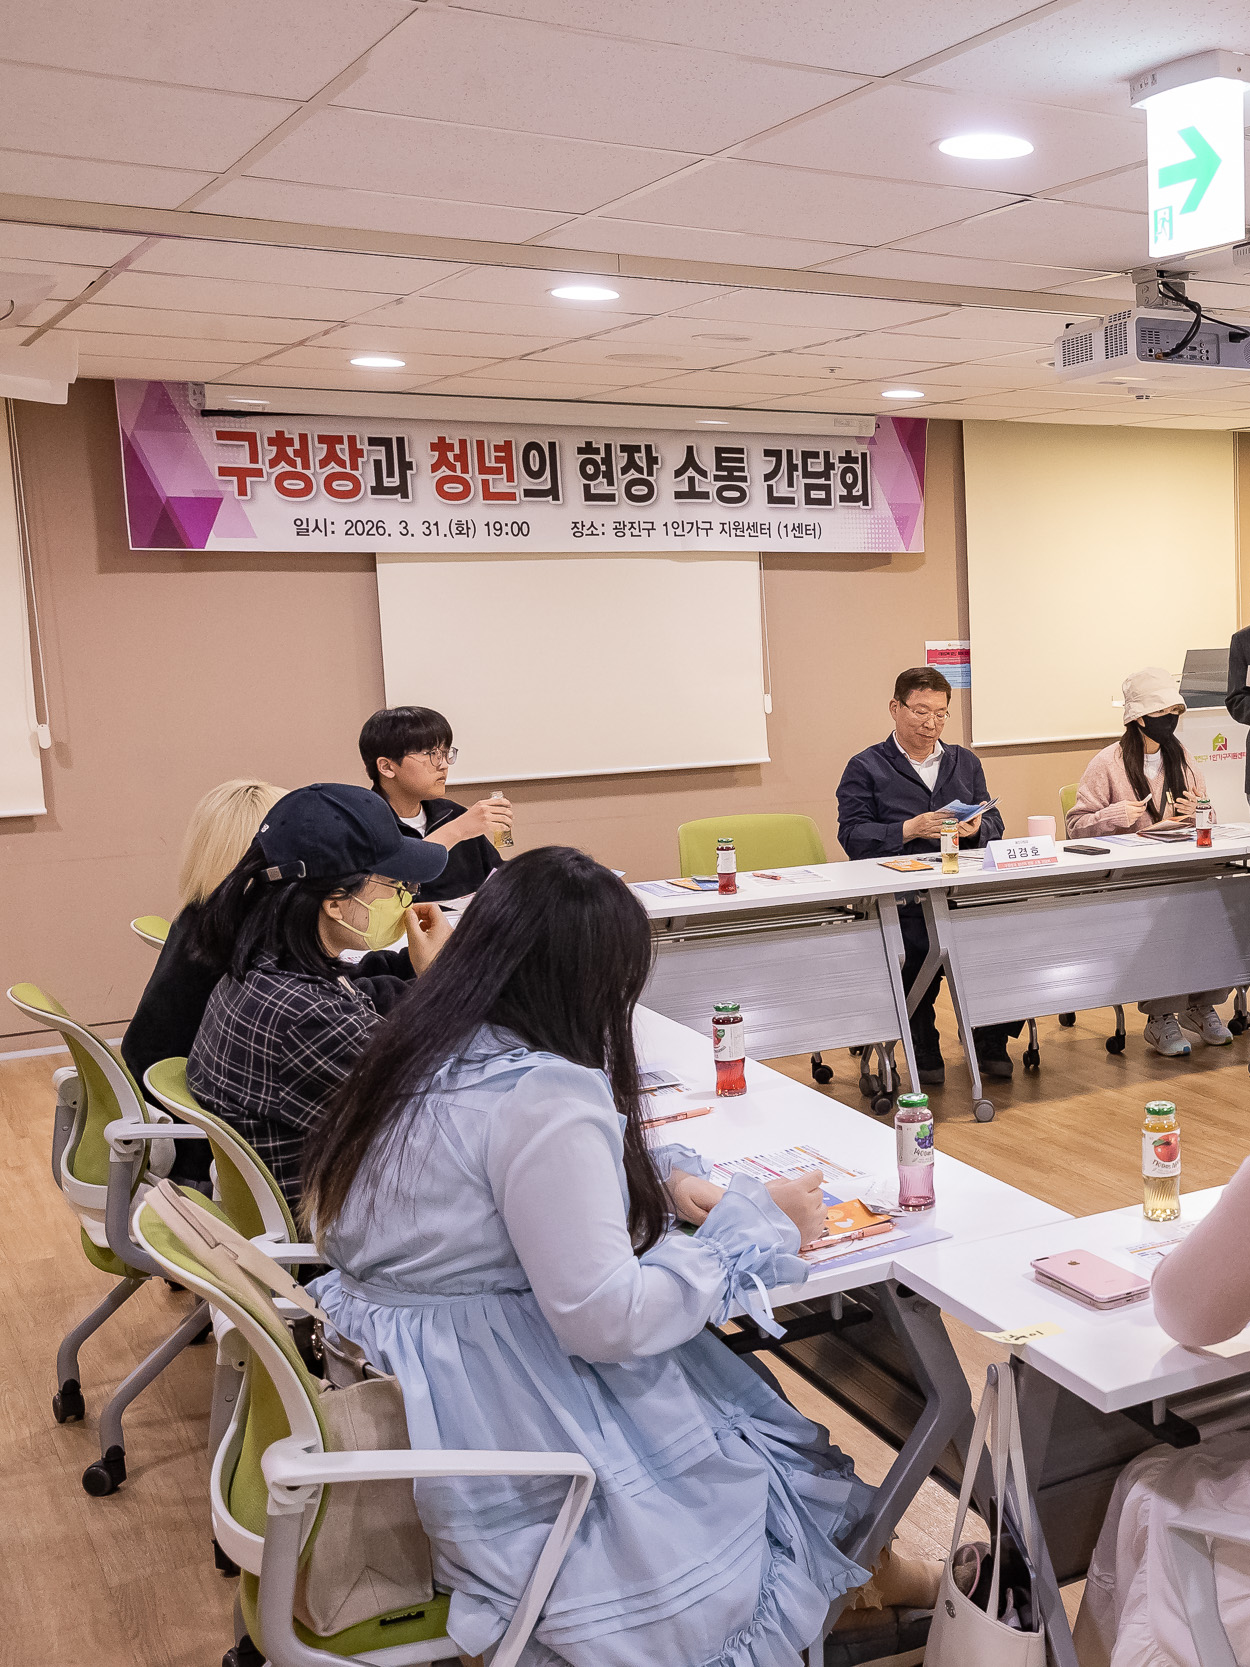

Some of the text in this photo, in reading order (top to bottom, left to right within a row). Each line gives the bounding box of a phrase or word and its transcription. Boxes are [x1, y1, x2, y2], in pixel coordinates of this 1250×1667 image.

[214, 429, 871, 507] 구청장과 청년의 현장 소통 간담회
[293, 517, 335, 537] 일시:
[344, 519, 392, 538] 2026.
[399, 519, 415, 538] 3.
[484, 520, 530, 537] 19:00
[570, 520, 823, 540] 장소: 광진구 1인가구 지원센터 (1센터)
